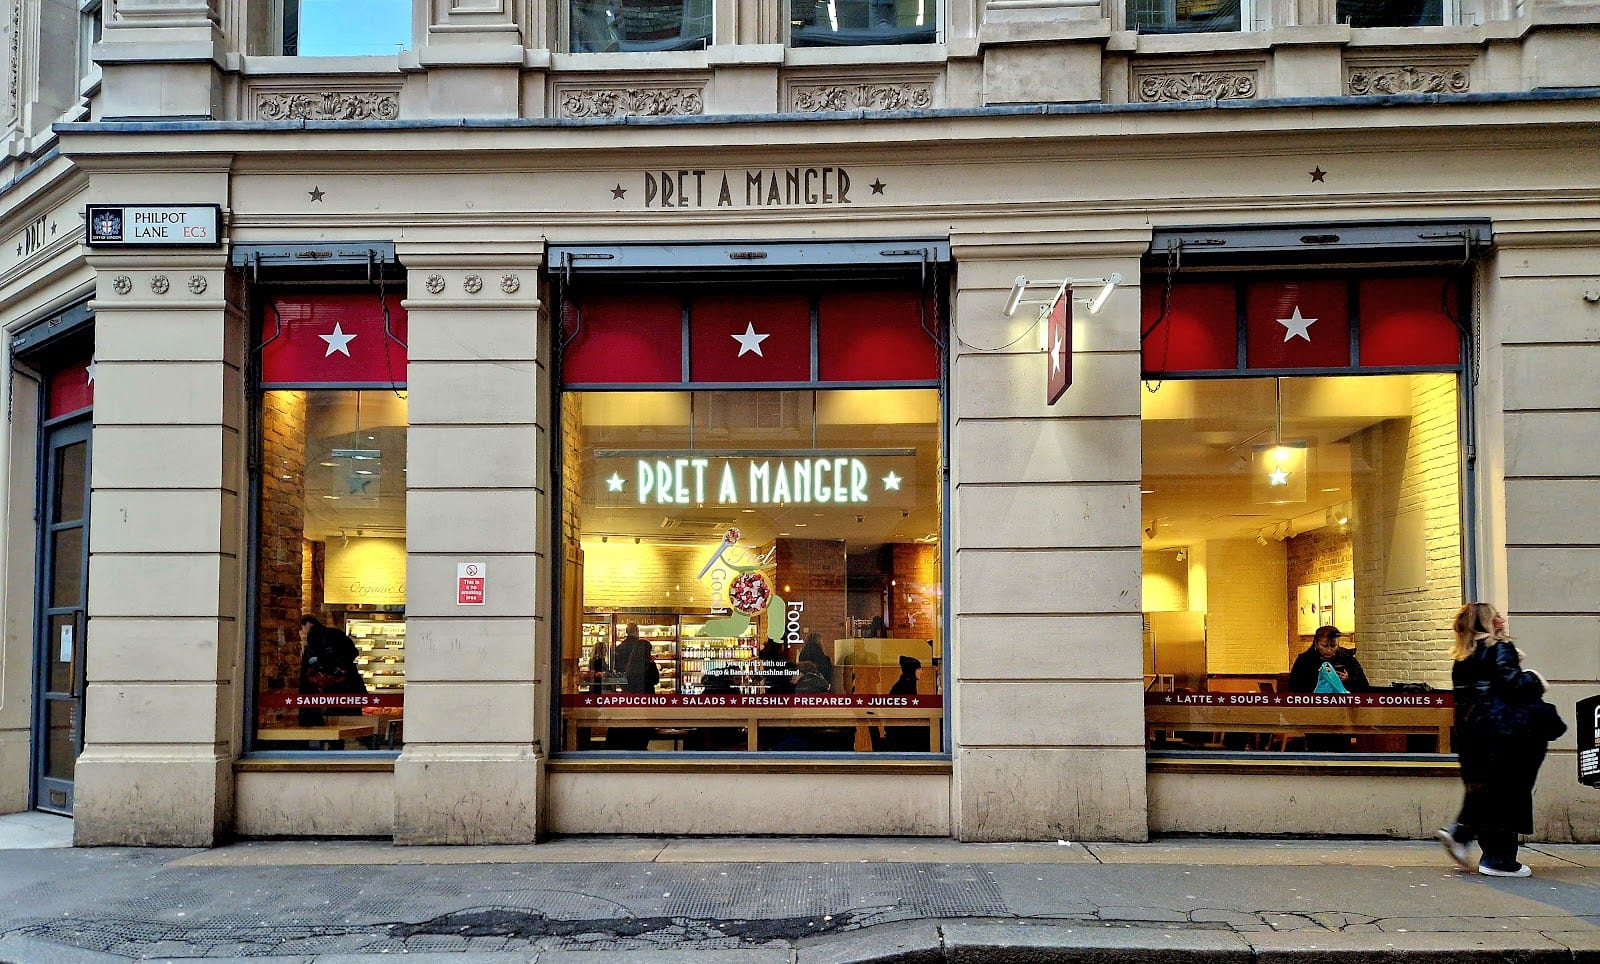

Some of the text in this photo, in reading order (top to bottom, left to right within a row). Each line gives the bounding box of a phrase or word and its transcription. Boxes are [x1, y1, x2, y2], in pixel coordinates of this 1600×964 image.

[645, 167, 852, 208] PRET A MANGER
[134, 212, 187, 224] PHILPOT
[135, 226, 207, 238] LANE EC3
[638, 458, 869, 504] PRET A MANGER
[296, 696, 369, 705] SANDWICHES
[596, 697, 908, 706] CAPPUCCINO SALADS FRESHLY PREPARED JUICES
[1177, 695, 1431, 705] LATTE SOUPS CROISSANTS COOKIES
